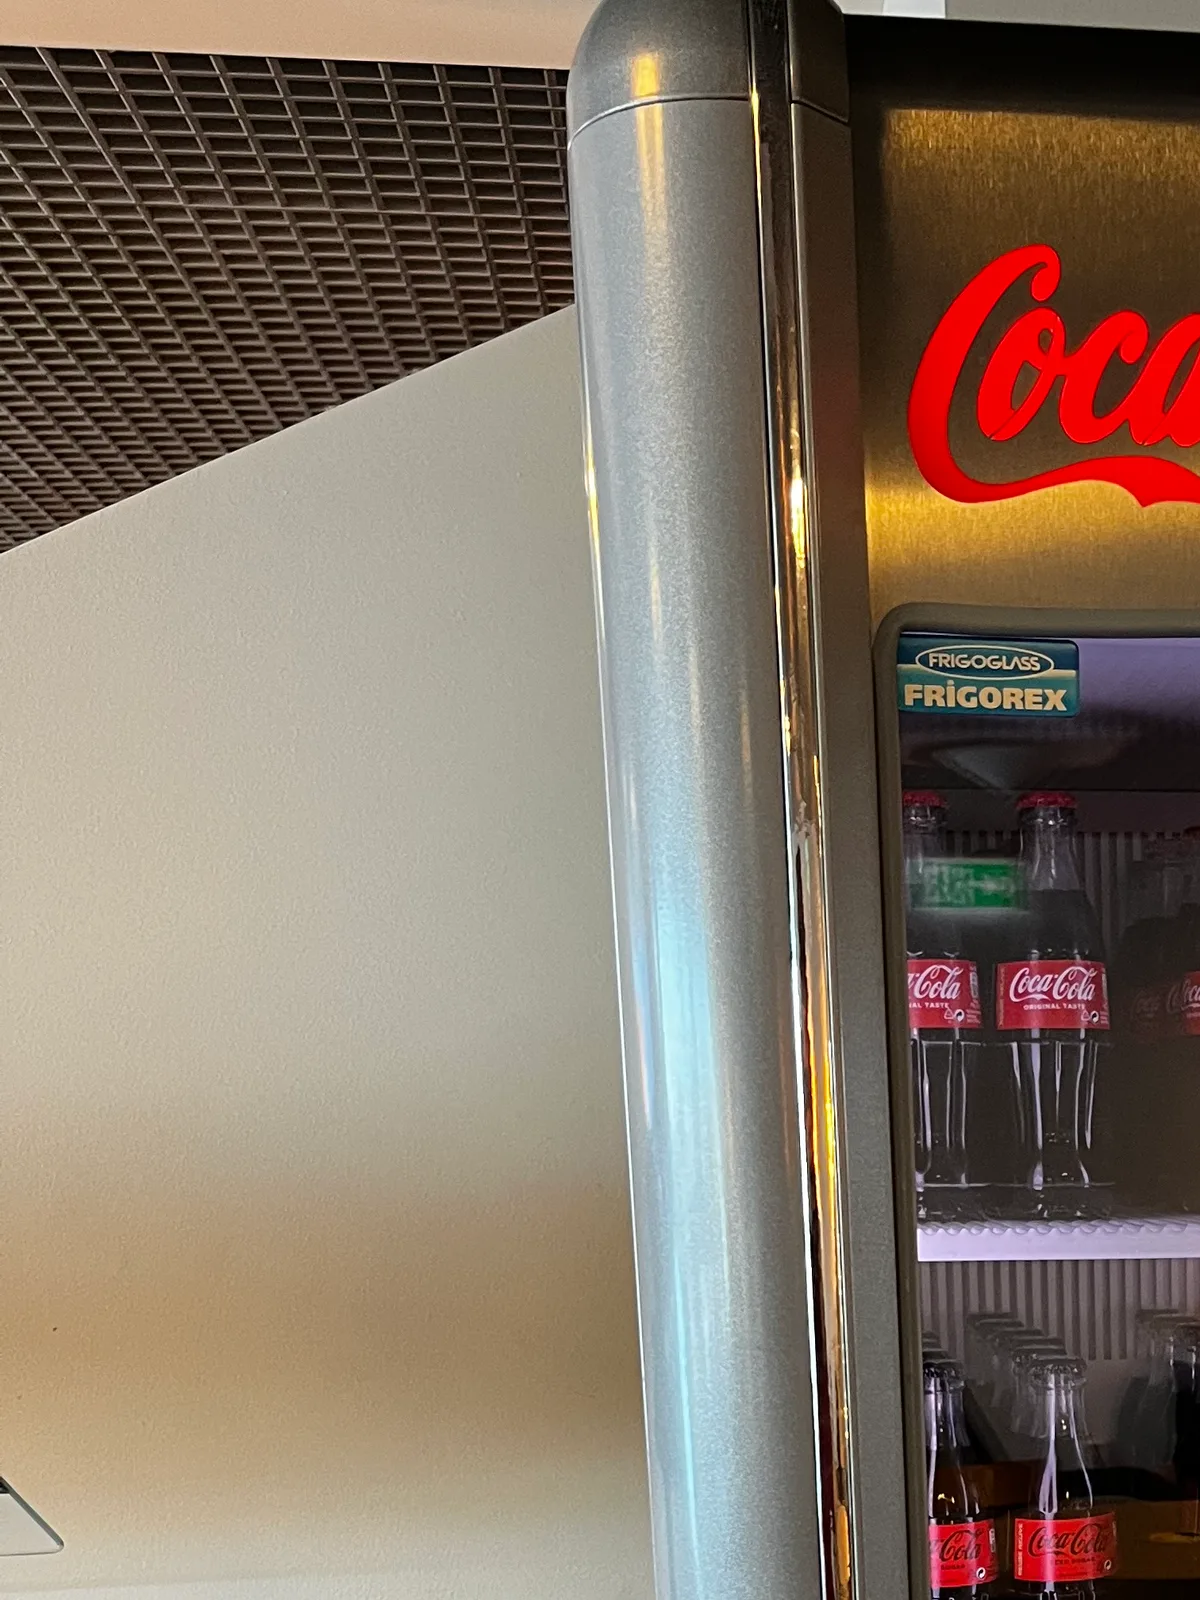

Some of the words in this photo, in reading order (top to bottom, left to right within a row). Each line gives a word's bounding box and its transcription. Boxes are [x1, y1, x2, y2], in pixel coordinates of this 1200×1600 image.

[929, 652, 1041, 672] FRIGOGLASS
[1009, 966, 1098, 1002] Coca-Cola
[1028, 1523, 1110, 1557] Coca-Cola
